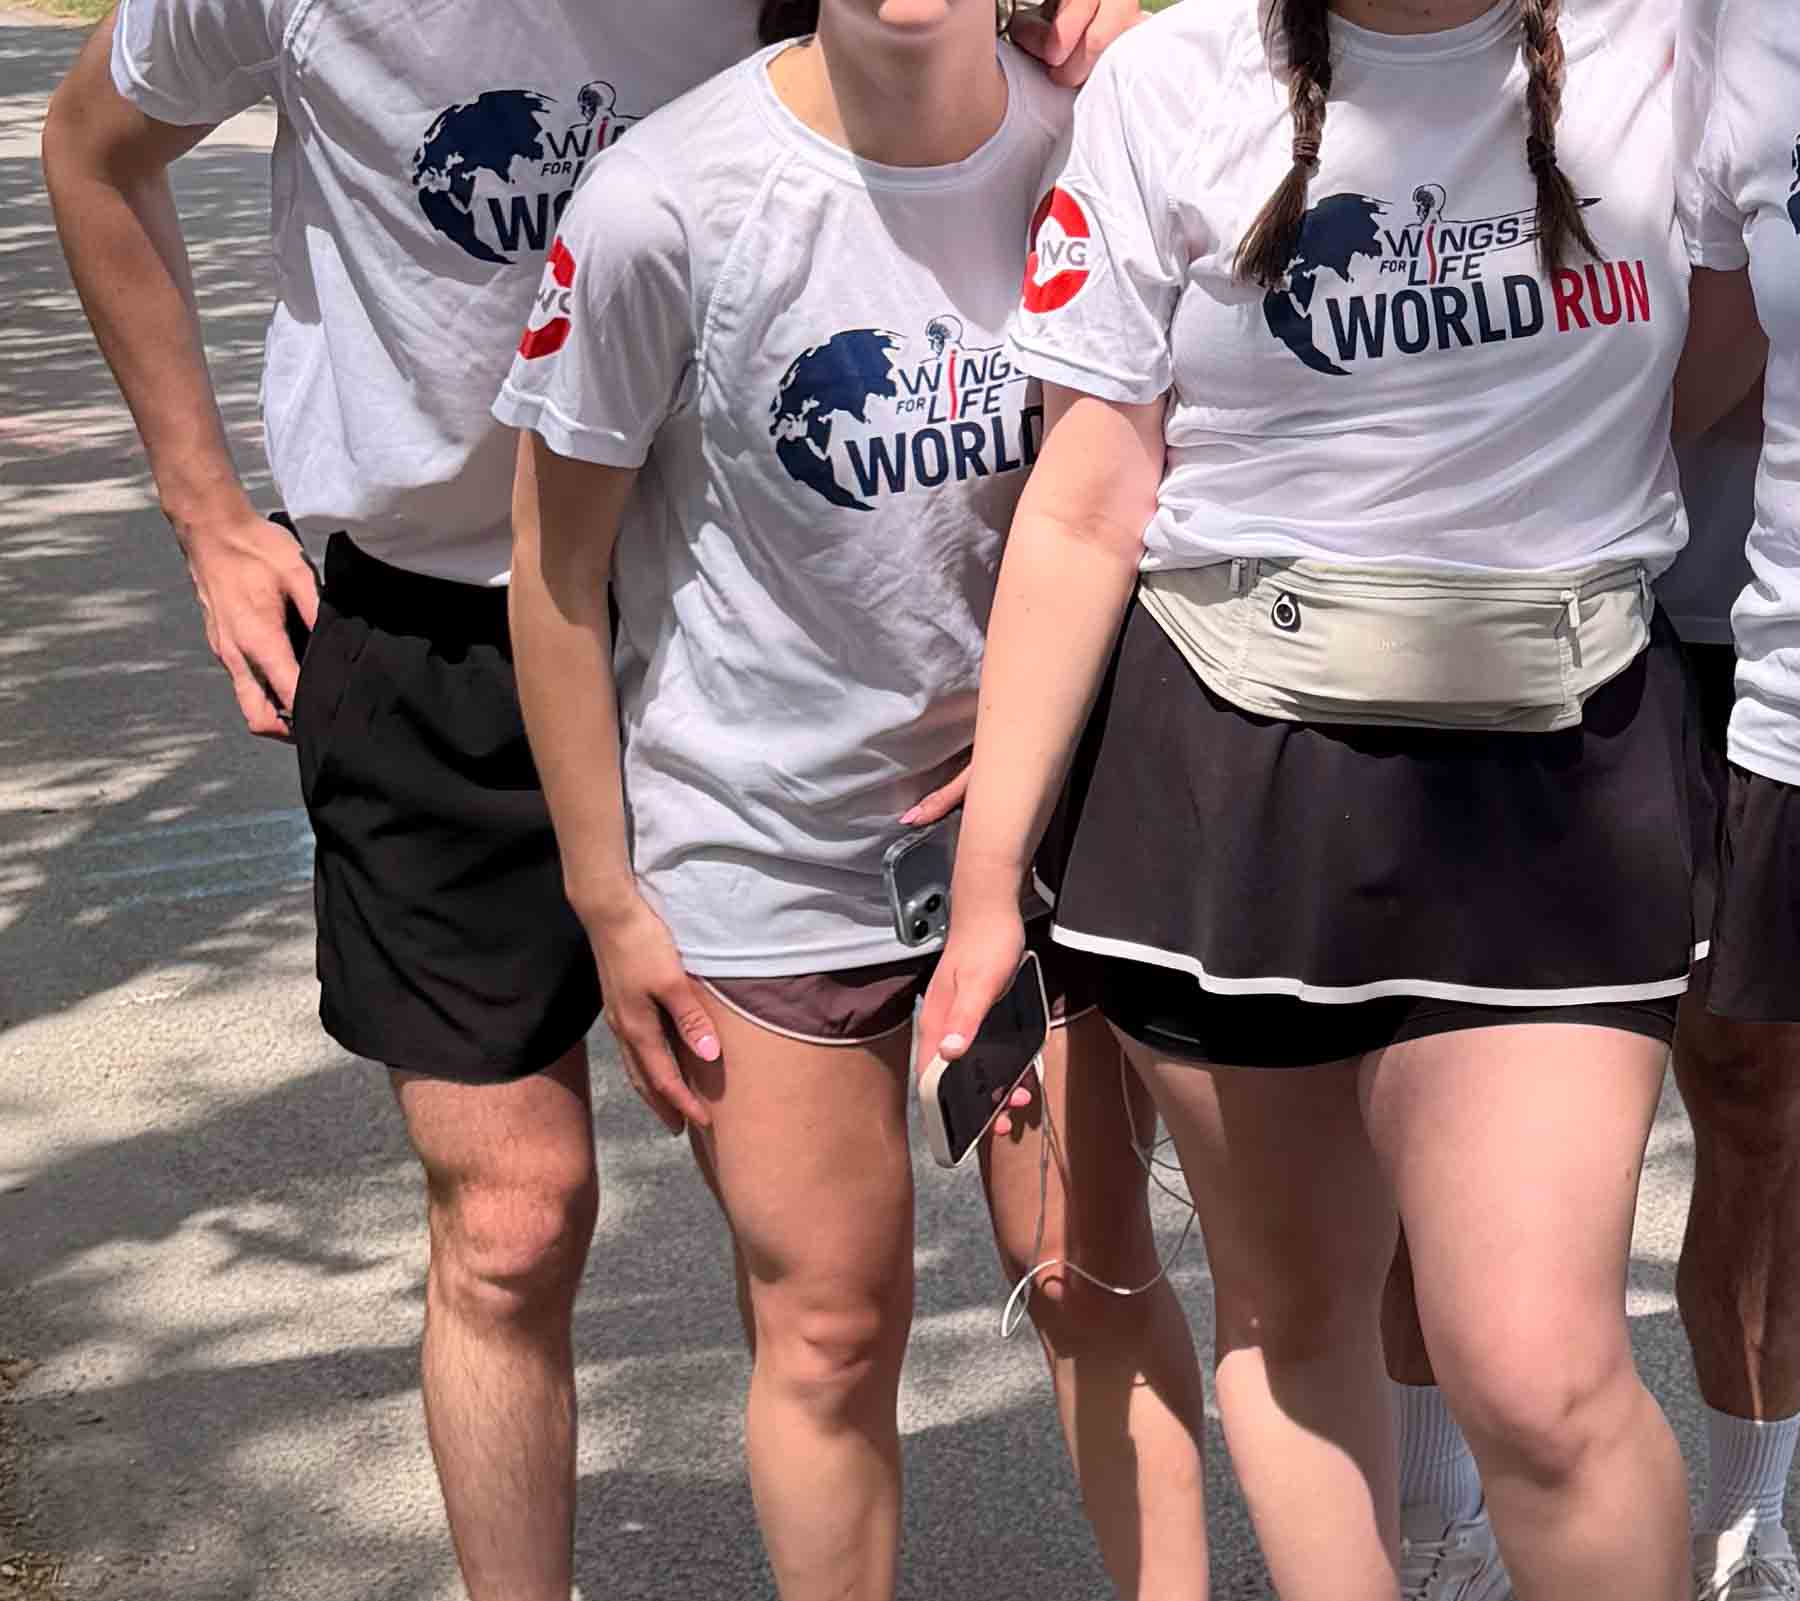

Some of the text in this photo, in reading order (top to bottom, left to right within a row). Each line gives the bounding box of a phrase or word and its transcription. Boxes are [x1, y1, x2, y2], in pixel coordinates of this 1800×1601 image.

[541, 161, 572, 176] FOR
[1384, 217, 1520, 258] WINGS
[1380, 252, 1485, 286] FOR LIFE
[1327, 260, 1650, 361] WORLD RUN
[898, 349, 1023, 395] WING
[896, 383, 1005, 424] FOR LIFE
